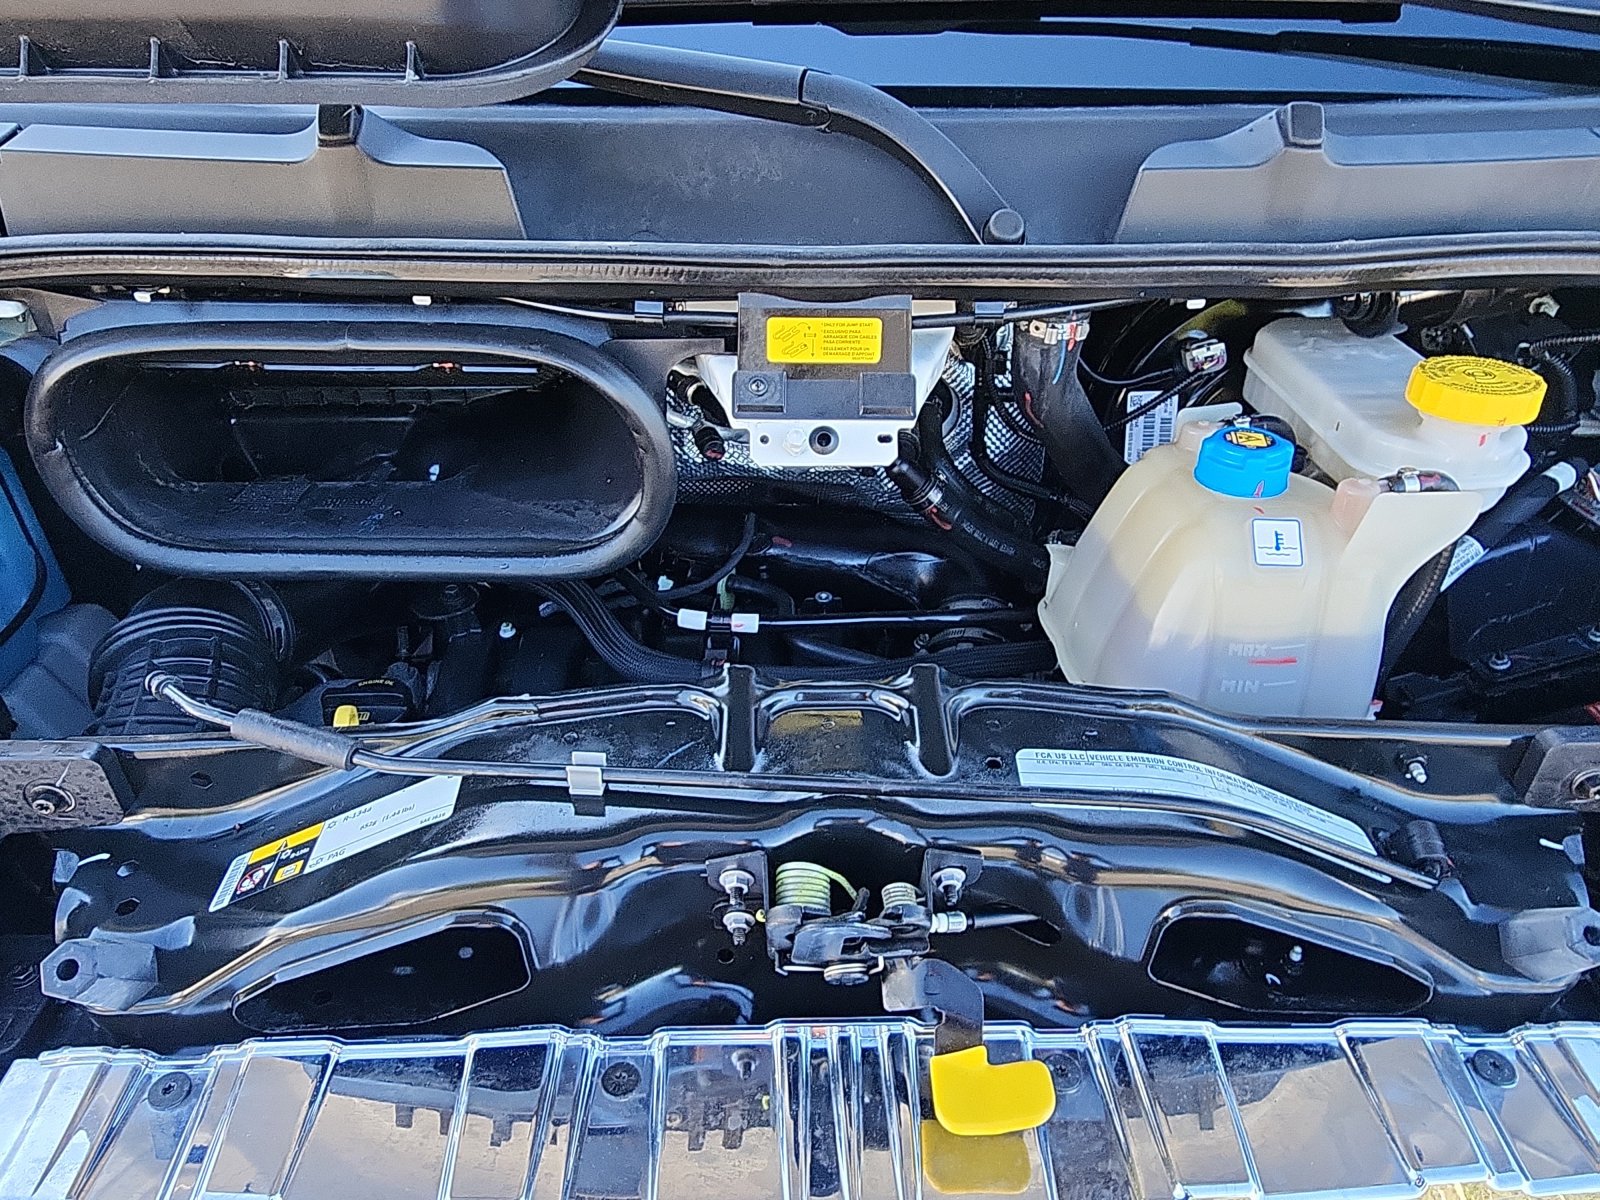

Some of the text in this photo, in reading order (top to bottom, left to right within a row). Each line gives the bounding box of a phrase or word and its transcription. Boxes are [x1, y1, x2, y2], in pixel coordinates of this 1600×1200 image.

[1228, 644, 1267, 656] MAX
[1220, 679, 1260, 693] MIN
[1126, 756, 1165, 764] EMISSION
[1166, 760, 1203, 772] CONTROL
[1204, 768, 1254, 789] INFORMATION
[342, 806, 372, 822] R-134a
[327, 848, 346, 862] PAG
